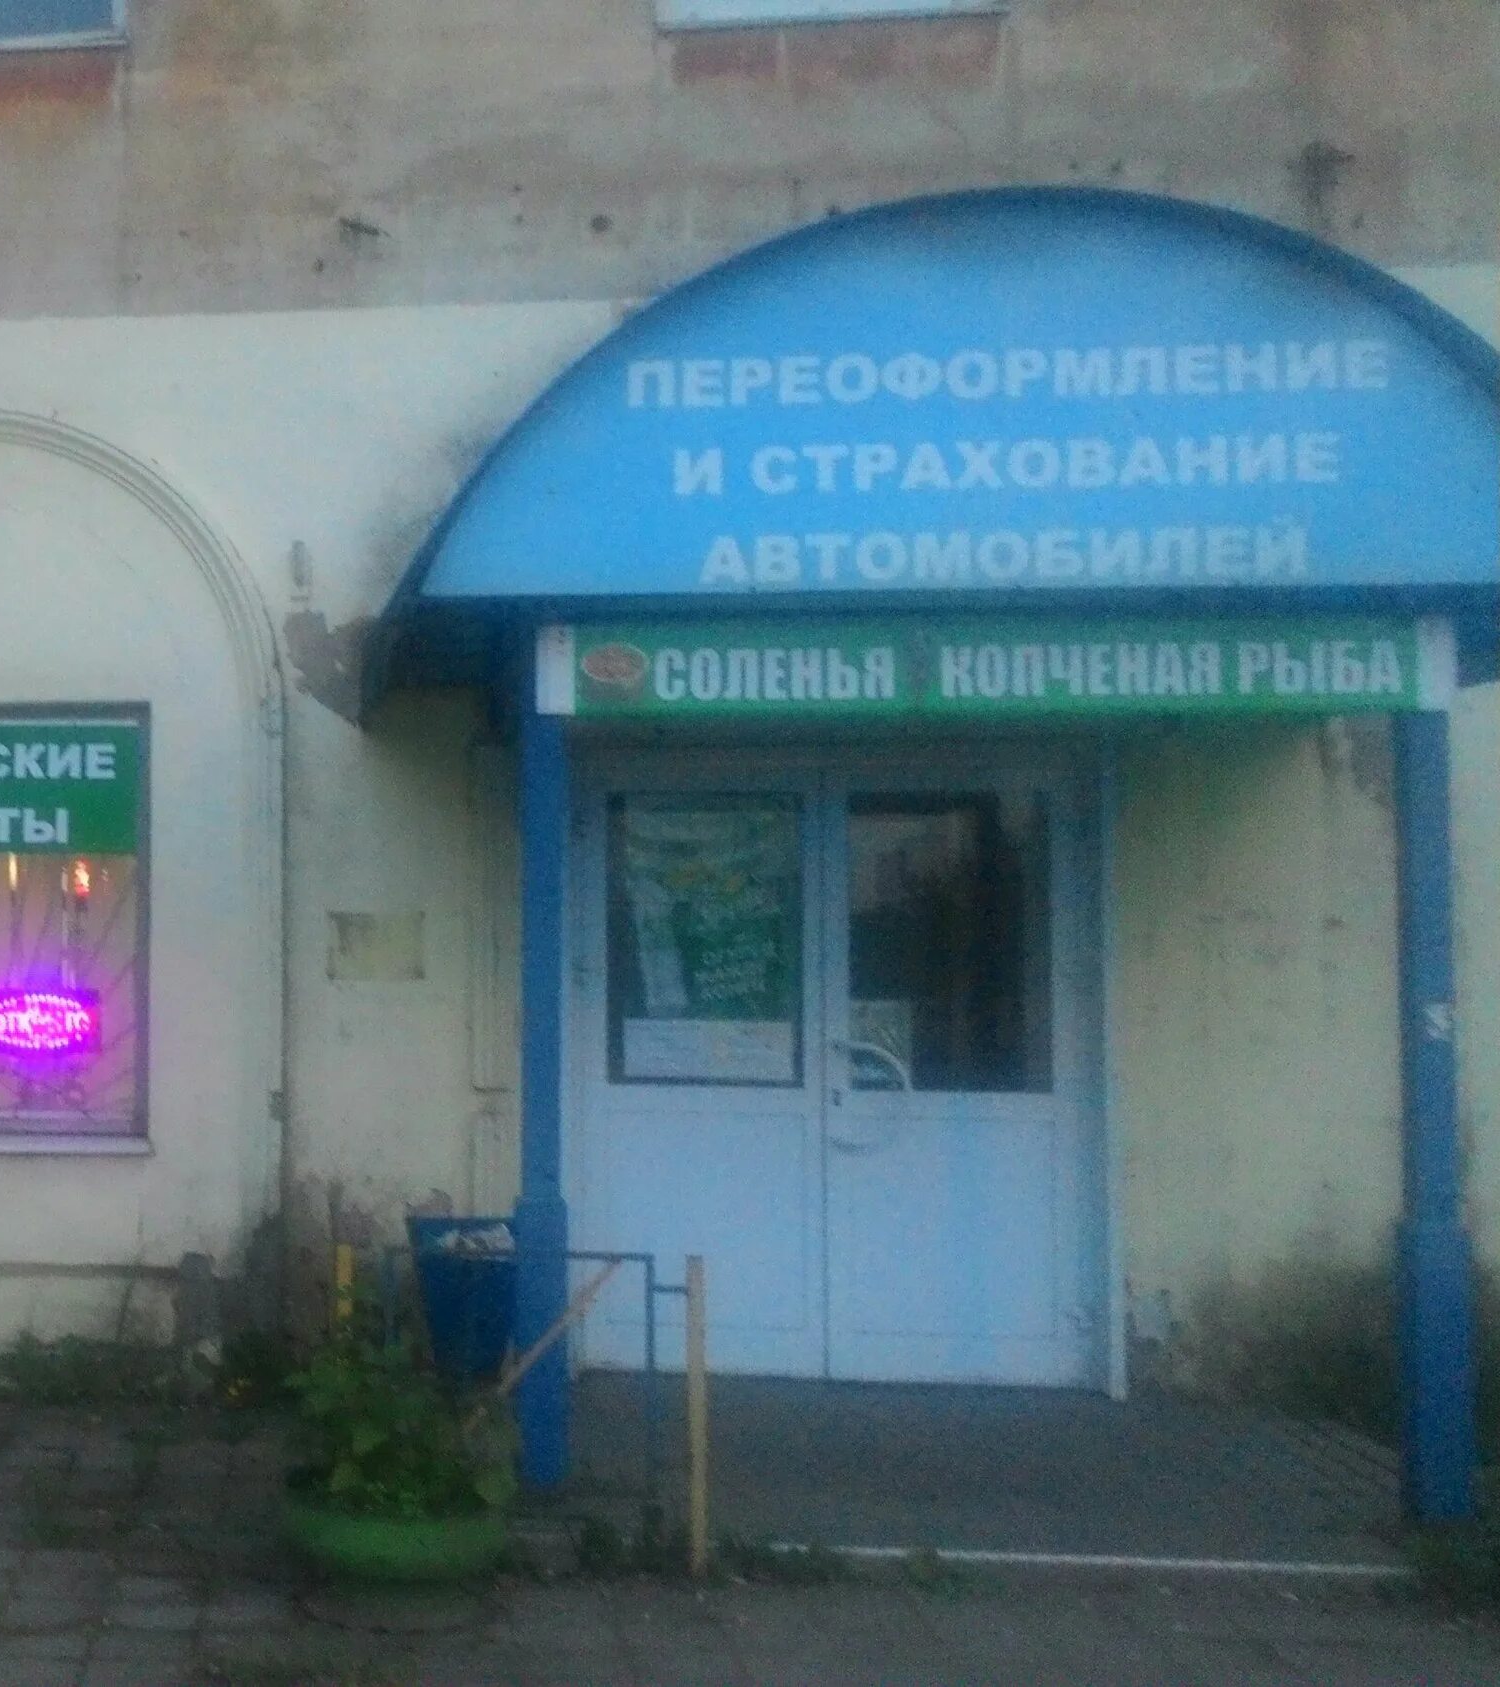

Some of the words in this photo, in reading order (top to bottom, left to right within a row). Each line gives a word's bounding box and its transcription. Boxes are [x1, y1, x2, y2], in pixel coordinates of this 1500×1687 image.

[626, 337, 1391, 408] ПЕРЕОФОРМЛЕНИЕ
[672, 447, 723, 496] И
[750, 431, 1342, 496] СТРАХОВАНИЕ
[700, 516, 1310, 587] АВТОМОБИЛЕЙ
[654, 647, 895, 700] СОЛЕНЬЯ
[939, 641, 1222, 699] КОПЧЕНАЯ
[1237, 639, 1402, 694] РЫБА
